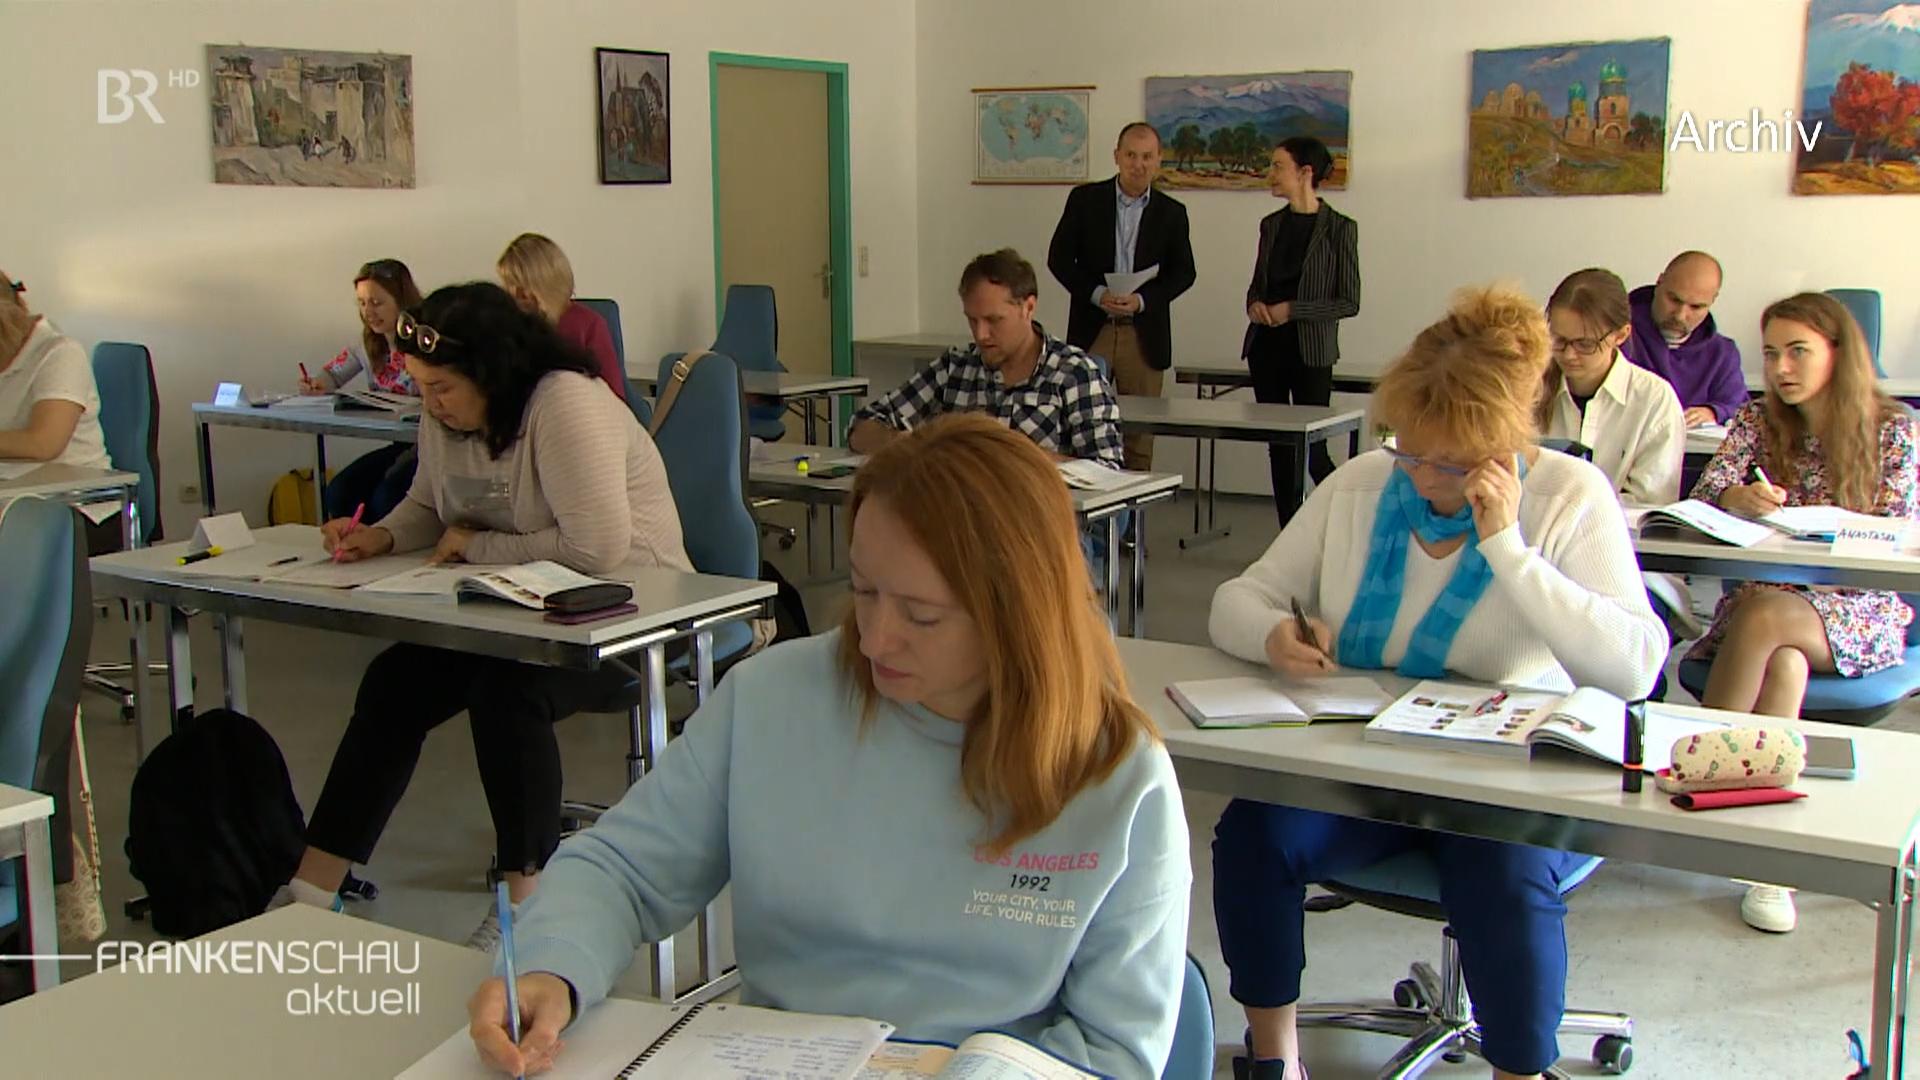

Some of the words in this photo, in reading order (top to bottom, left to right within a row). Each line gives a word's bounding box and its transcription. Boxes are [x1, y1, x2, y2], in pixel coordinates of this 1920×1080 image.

[1017, 852, 1098, 872] ANGELES
[1010, 873, 1050, 891] 1992
[972, 889, 1008, 904] YOUR
[1042, 898, 1076, 912] YOUR
[997, 907, 1034, 924] YOUR
[1035, 913, 1078, 928] RULES
